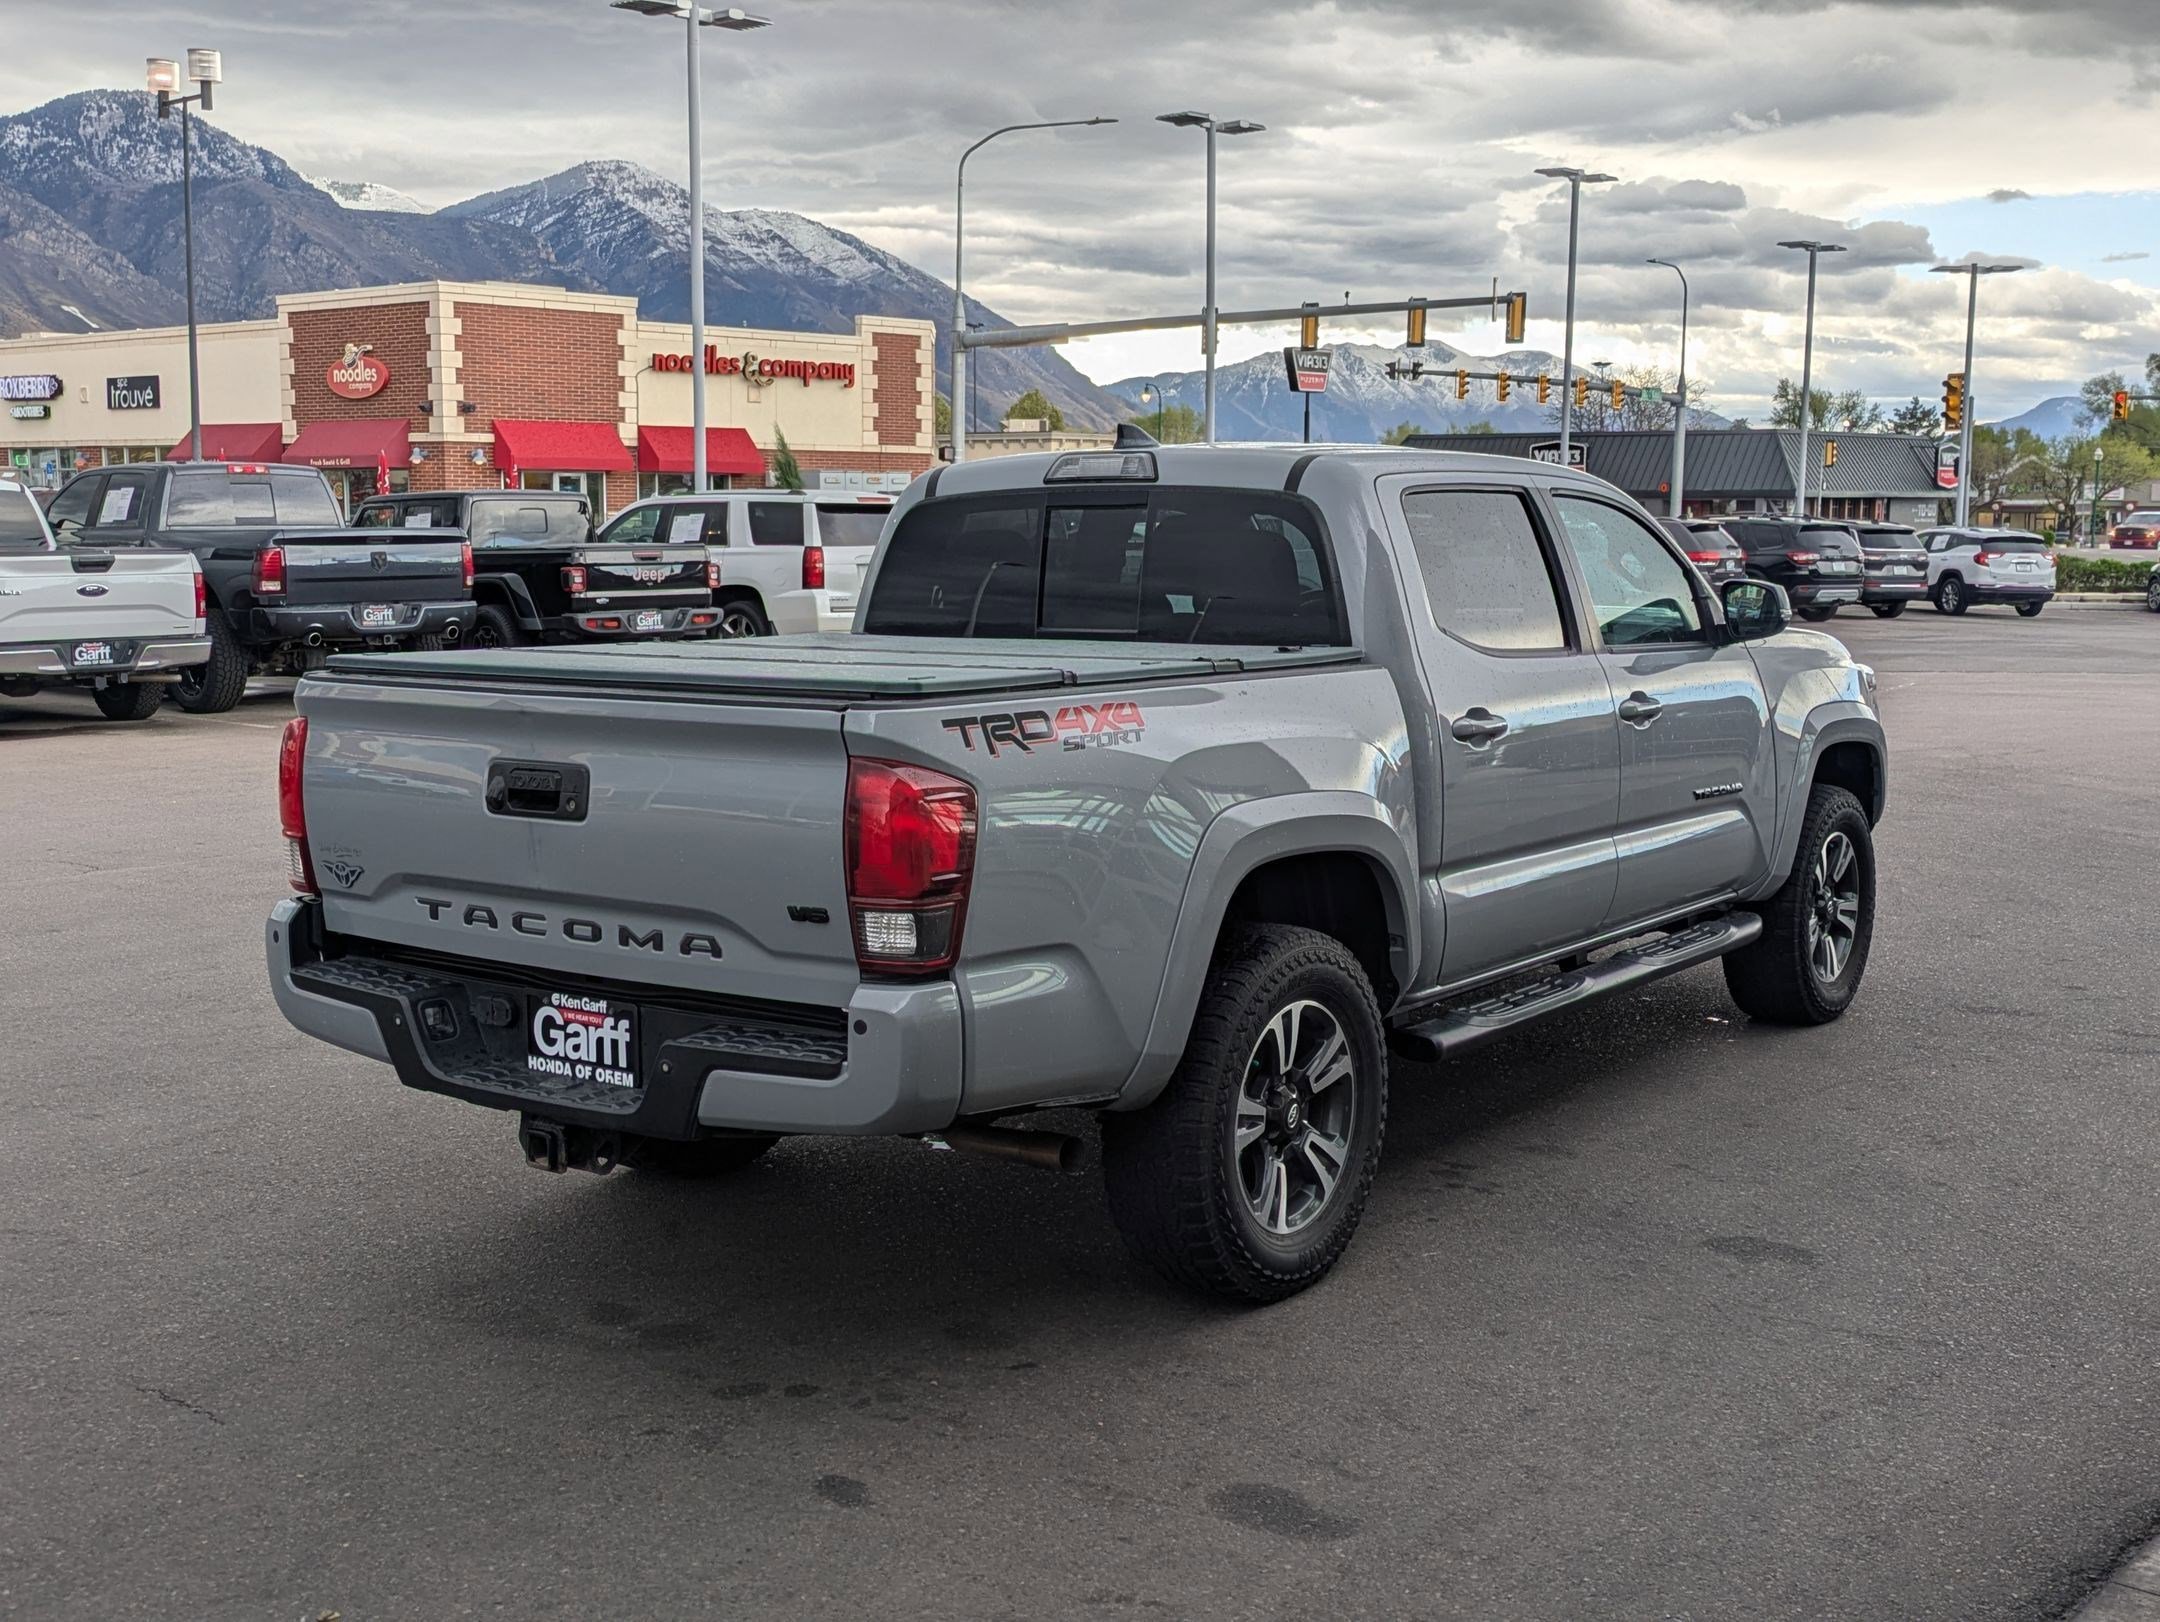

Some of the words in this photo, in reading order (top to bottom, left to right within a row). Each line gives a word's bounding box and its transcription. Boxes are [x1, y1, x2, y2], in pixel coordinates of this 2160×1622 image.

[333, 360, 378, 383] noodles
[743, 351, 774, 387] &
[759, 359, 855, 388] company
[1297, 355, 1328, 369] VIA313
[111, 385, 154, 408] trouvé
[1533, 449, 1581, 463] VIA13
[632, 567, 666, 583] Jeep
[363, 608, 393, 621] Garff
[637, 613, 662, 626] Garff
[75, 646, 111, 661] Garff
[941, 710, 1058, 758] TRD
[1063, 728, 1146, 752] SPORT
[414, 896, 723, 960] TACOMA
[560, 994, 581, 1009] Ken
[581, 997, 607, 1014] Garff
[533, 1006, 630, 1068] Garff
[528, 1055, 573, 1077] HONDA
[575, 1064, 593, 1080] OF
[595, 1068, 634, 1088] OREM
